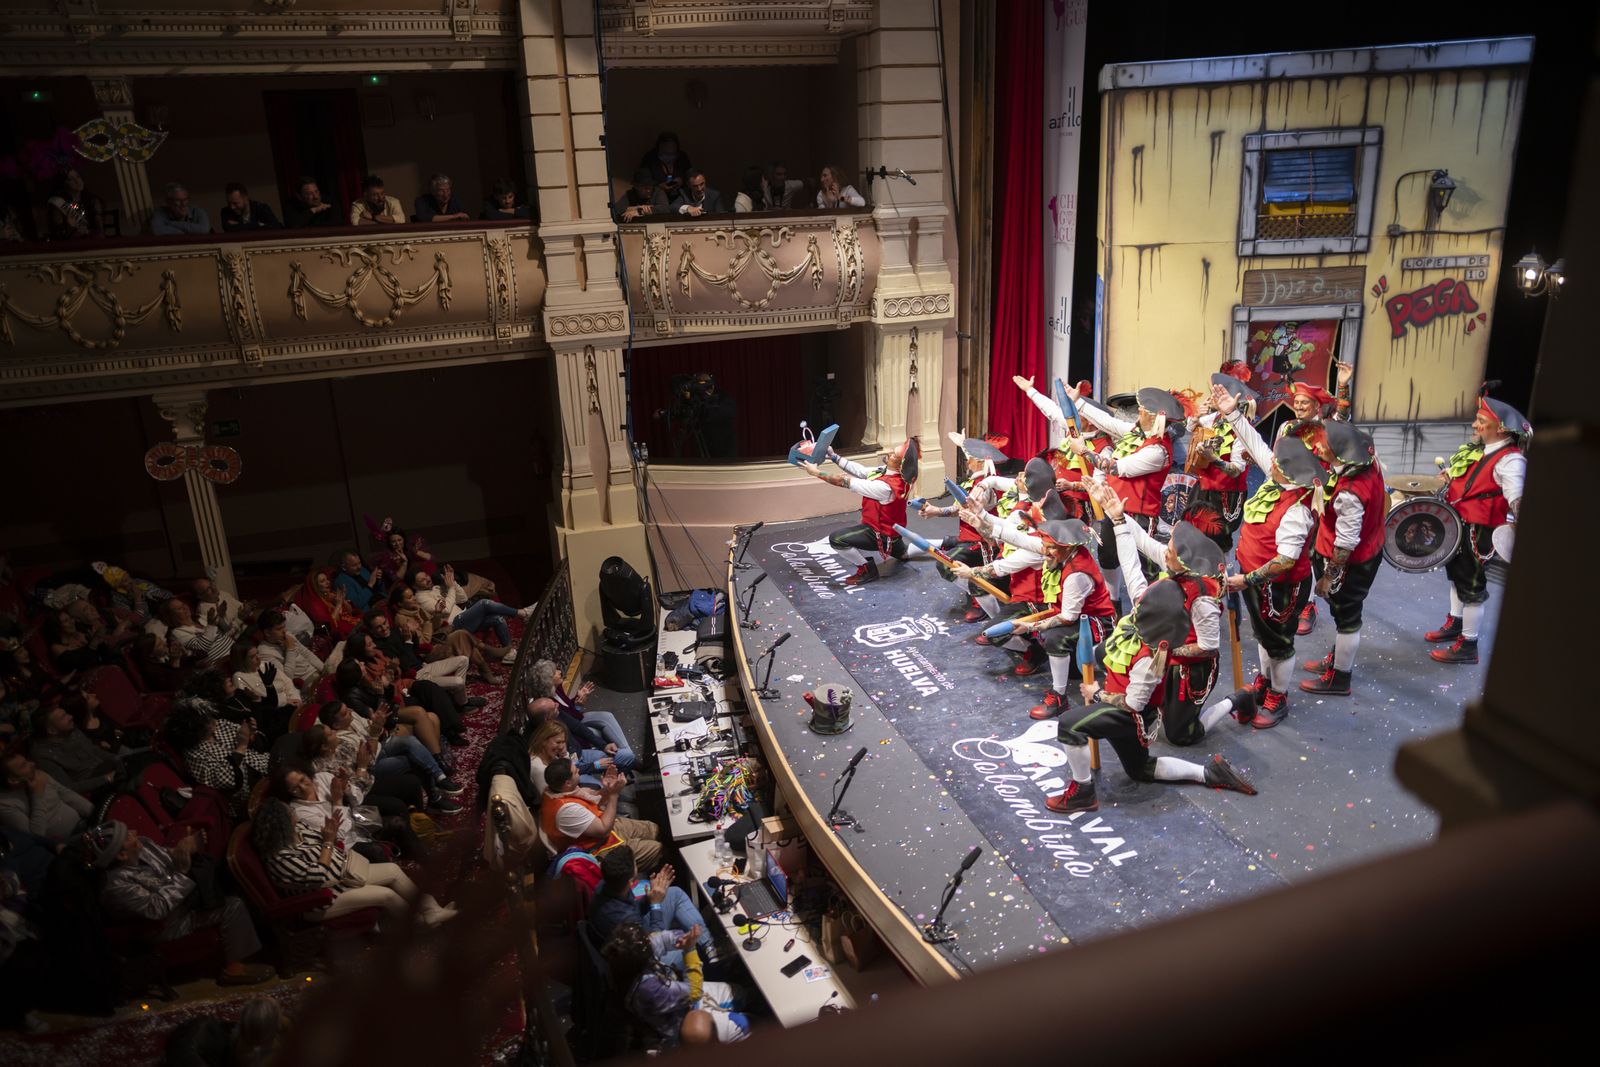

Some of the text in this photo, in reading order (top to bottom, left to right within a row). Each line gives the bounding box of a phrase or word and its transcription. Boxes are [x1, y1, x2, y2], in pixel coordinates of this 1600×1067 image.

[1405, 256, 1485, 268] LOPE DE
[1385, 277, 1479, 340] PEGA
[883, 649, 940, 697] HUELVA
[906, 646, 955, 691] Ayuntamiento de
[952, 735, 1094, 878] Colombino
